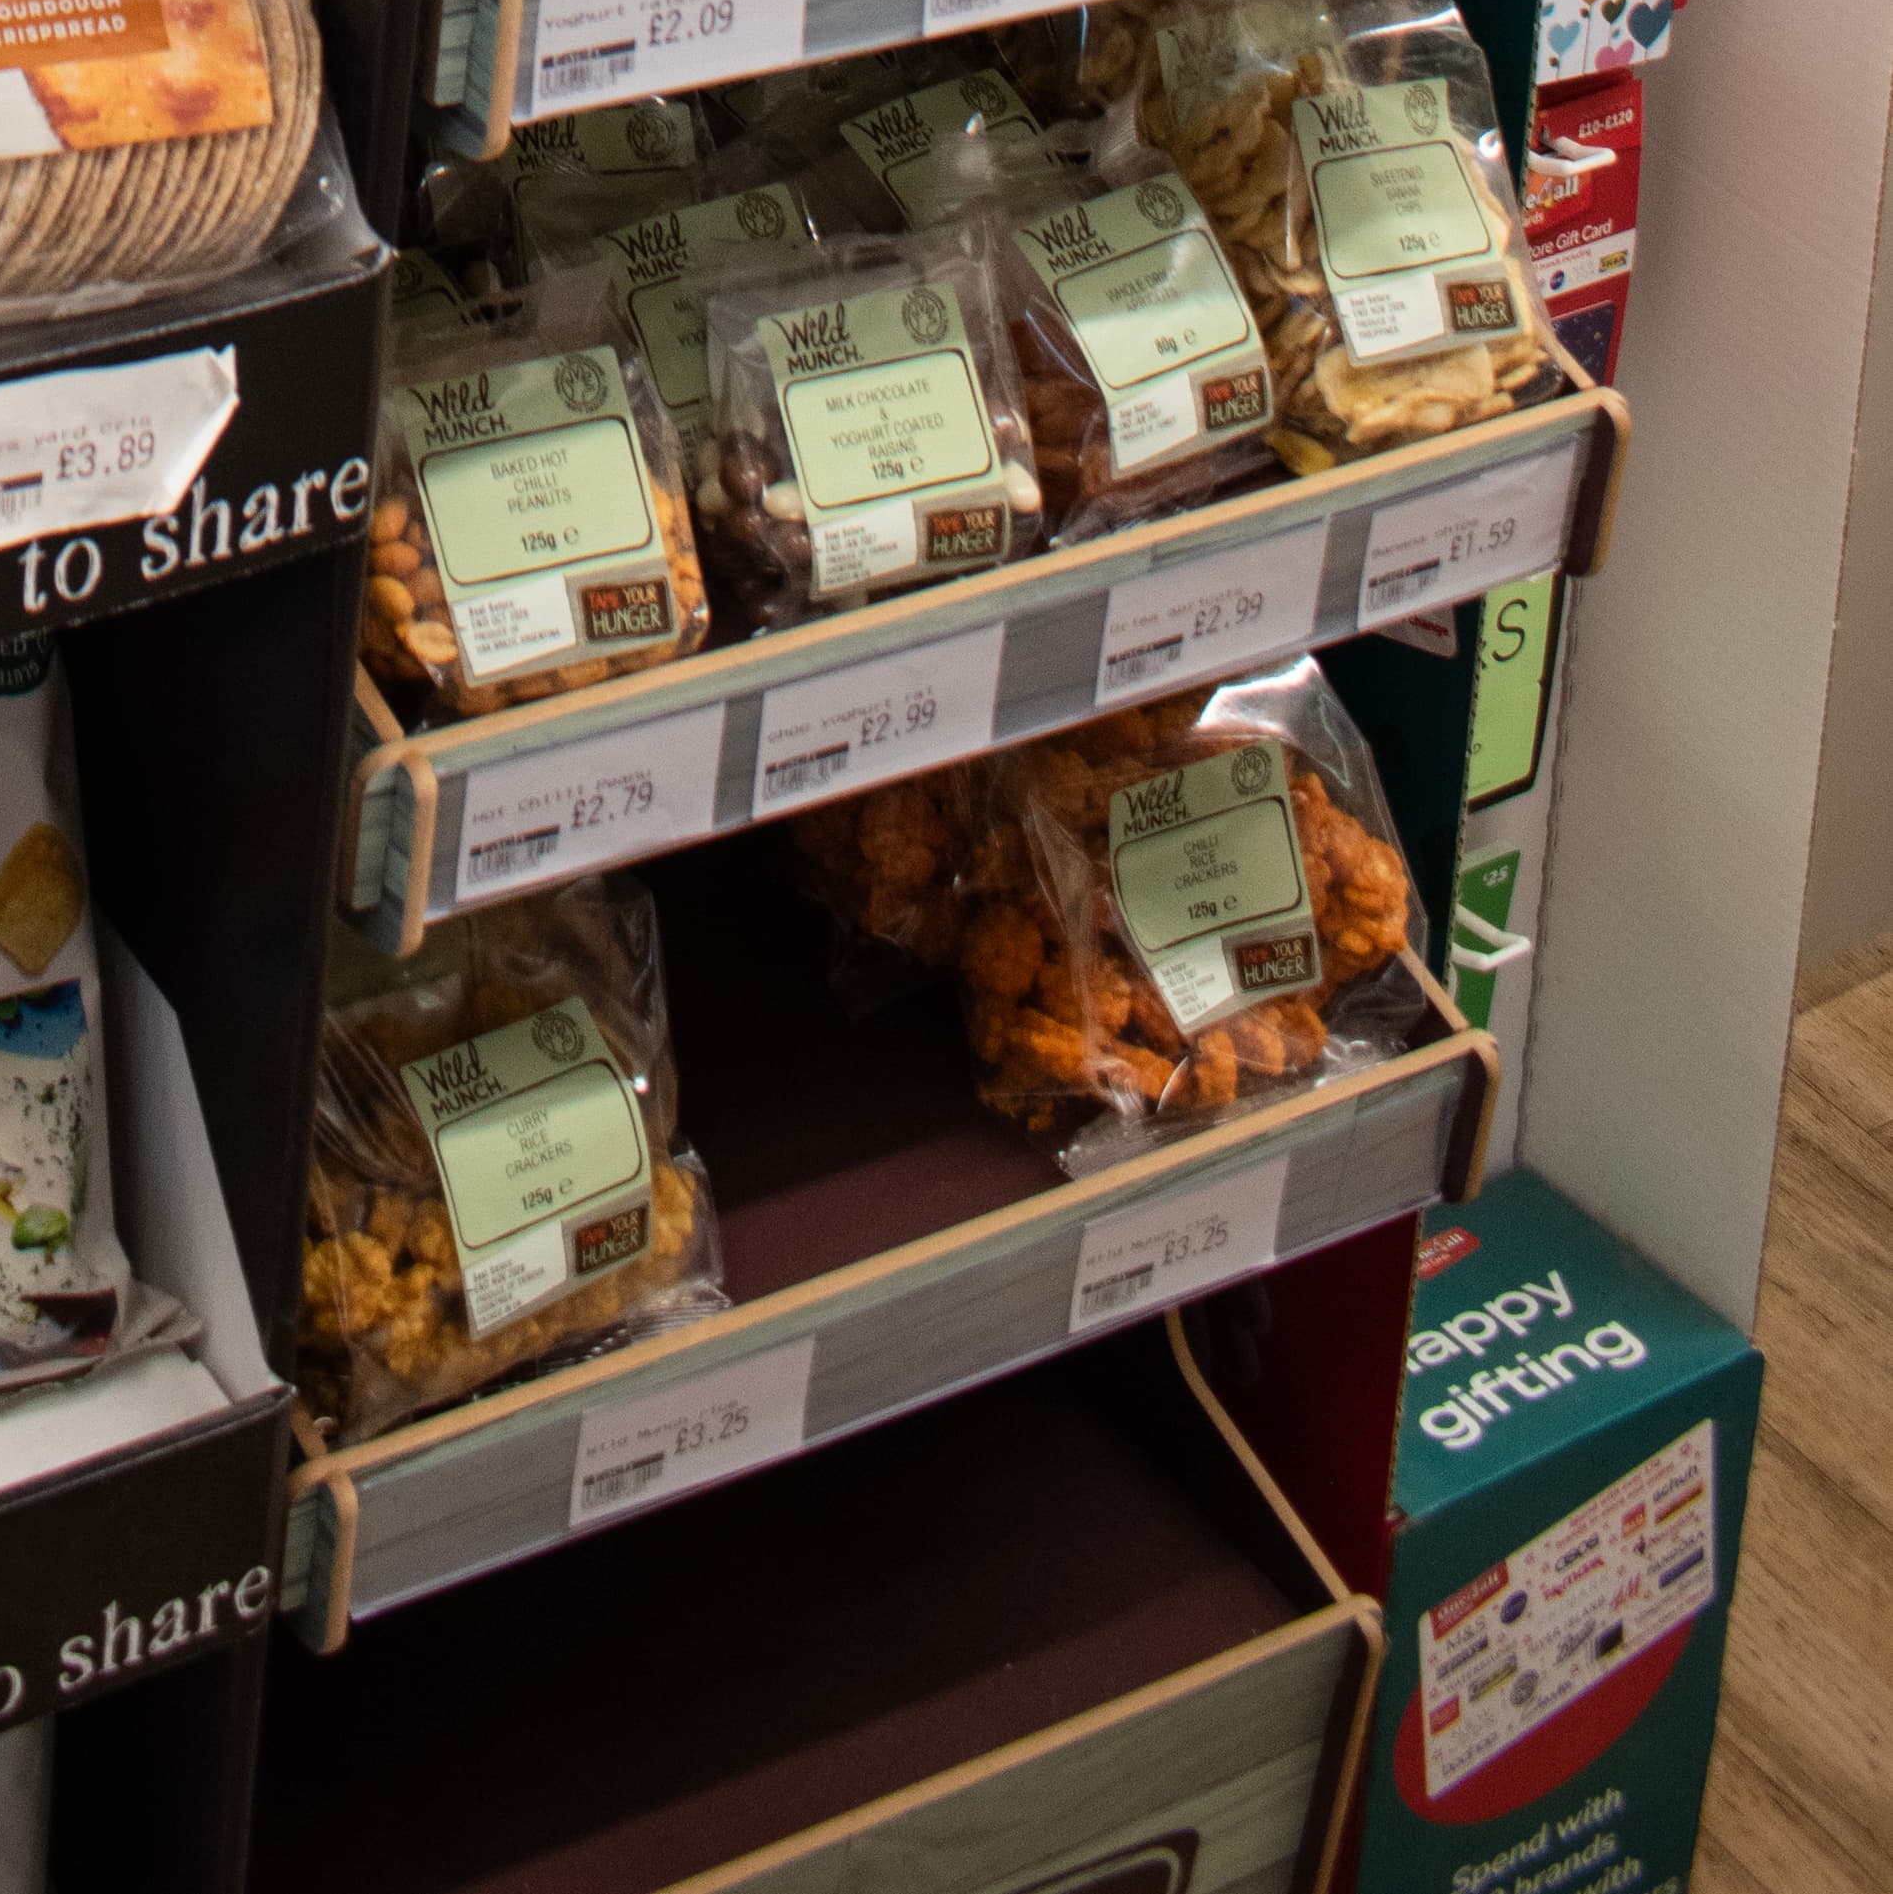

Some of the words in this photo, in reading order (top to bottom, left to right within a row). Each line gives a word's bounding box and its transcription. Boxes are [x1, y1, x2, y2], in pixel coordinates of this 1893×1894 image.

[647, 0, 735, 48] £2.09
[1309, 91, 1372, 132] Wild
[1578, 108, 1634, 138] £10-£120
[1019, 207, 1097, 254] Wild
[775, 302, 851, 354] Wild
[1456, 299, 1512, 327] HUNGER
[414, 372, 496, 425] Wild
[54, 432, 157, 482] £3.89
[491, 457, 536, 477] BAKED
[539, 448, 569, 468] HOT
[507, 487, 572, 514] PEANUTS
[17, 537, 103, 612] to
[139, 454, 371, 582] share
[521, 530, 556, 553] 125g
[932, 527, 996, 556] HUNGER
[1447, 517, 1516, 565] £1.59
[592, 600, 663, 635] HUNGER
[1191, 592, 1266, 638] £2.99
[1491, 598, 1529, 664] S
[857, 698, 938, 747] £2.99
[569, 781, 654, 832] £2.79
[1123, 769, 1185, 820] Wild
[1189, 850, 1217, 870] RICE
[1243, 952, 1307, 983] HUNGER
[409, 1040, 489, 1099] Wild
[506, 1108, 549, 1139] CURRY
[519, 1131, 549, 1153] RICE
[505, 1138, 573, 1178] CRACKERS
[521, 1185, 555, 1211] 125g
[581, 1227, 642, 1268] HUNGER
[1161, 1219, 1230, 1268] £3.25
[1418, 1317, 1648, 1452] gifting
[673, 1406, 750, 1458] £3.25
[57, 1561, 273, 1693] share
[1557, 1787, 1626, 1841] with
